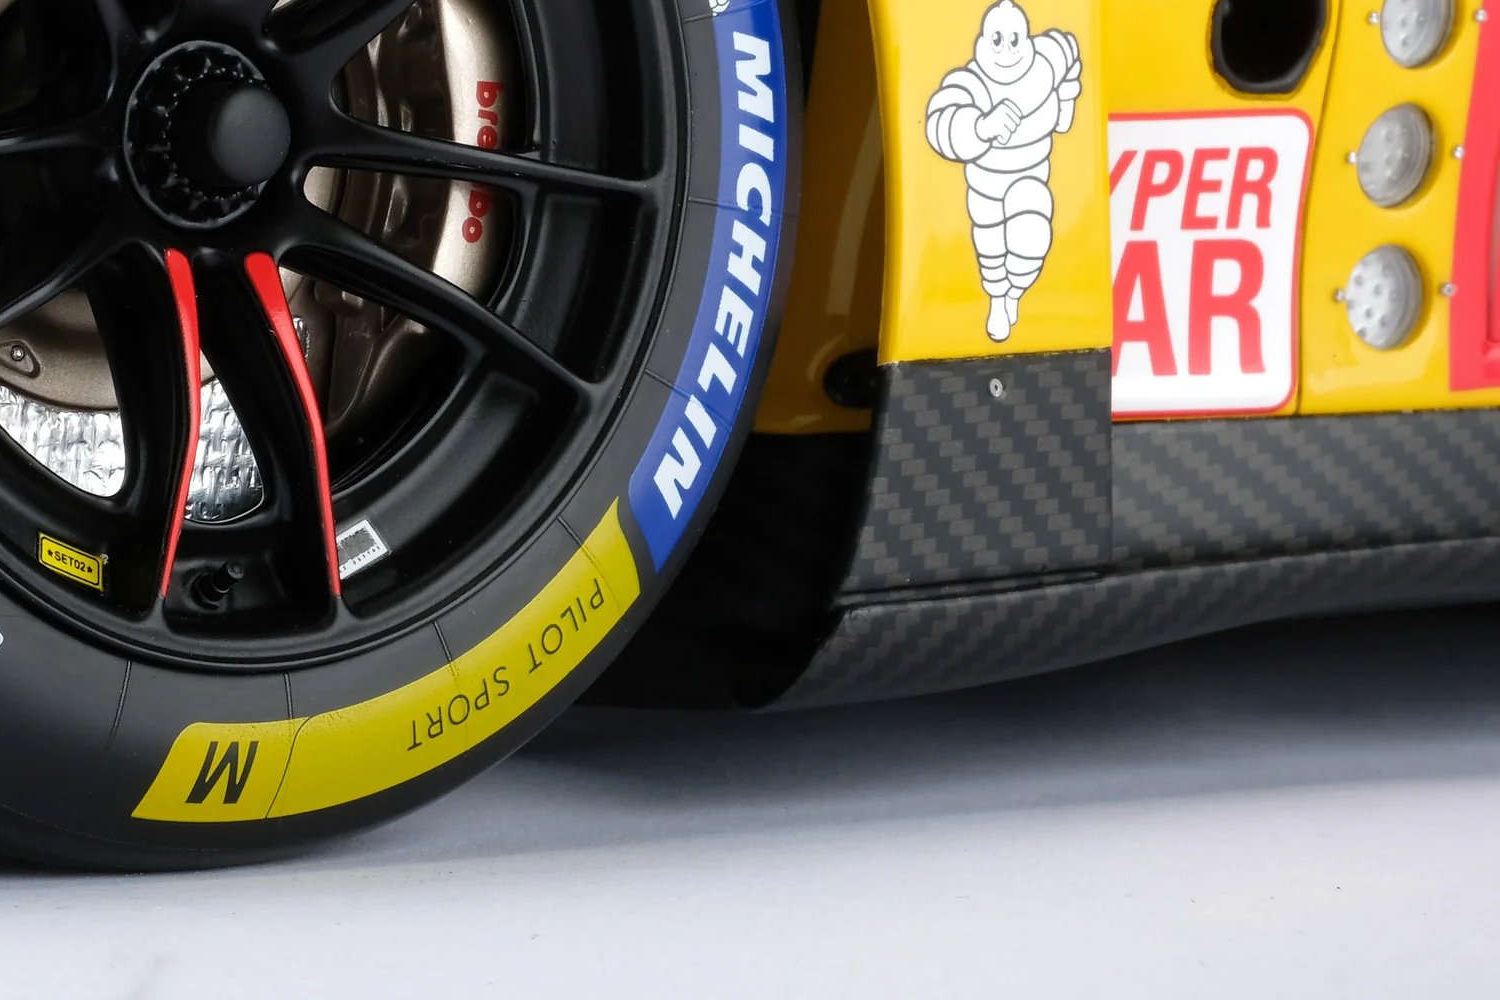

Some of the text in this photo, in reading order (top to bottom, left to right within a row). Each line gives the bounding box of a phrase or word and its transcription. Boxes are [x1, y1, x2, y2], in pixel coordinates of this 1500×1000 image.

[461, 80, 506, 244] brebo
[1108, 146, 1279, 231] PER
[651, 29, 776, 521] MICHELIN
[1111, 238, 1267, 377] AR
[54, 550, 87, 573] SET02
[406, 576, 606, 752] PILOT SPORT
